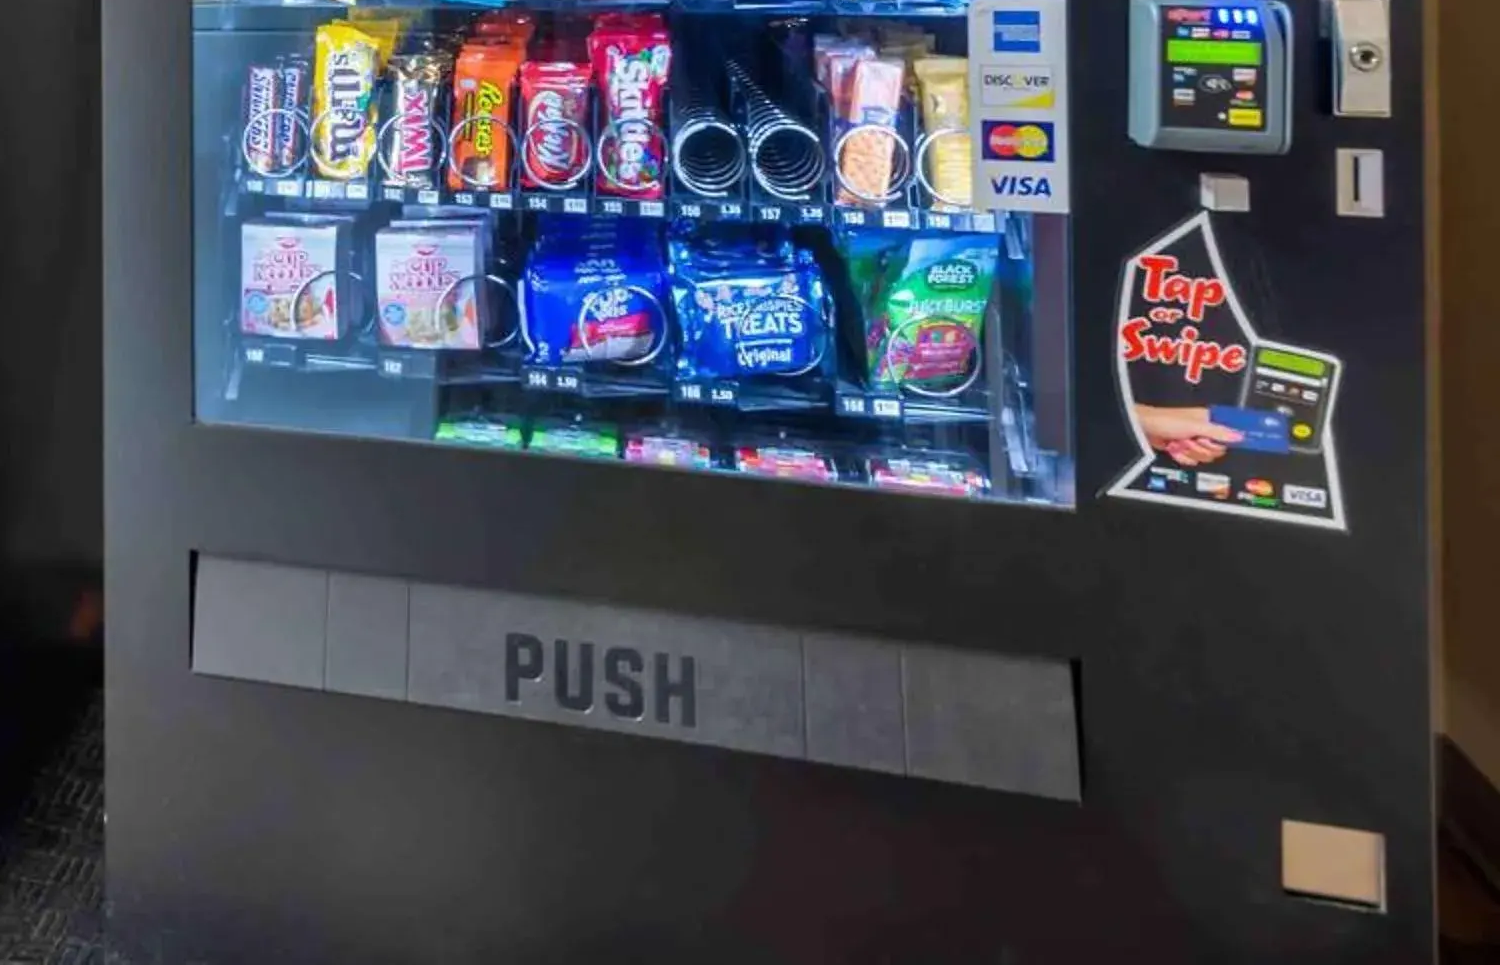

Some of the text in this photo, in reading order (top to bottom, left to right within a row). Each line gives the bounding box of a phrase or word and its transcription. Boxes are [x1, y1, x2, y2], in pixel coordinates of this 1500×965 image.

[991, 176, 1051, 197] VISA
[761, 208, 780, 220] 157
[1139, 254, 1226, 321] Tap
[1149, 308, 1184, 323] or
[1121, 318, 1247, 384] Swipe
[1289, 489, 1324, 502] VISA
[505, 632, 696, 728] PUSH
